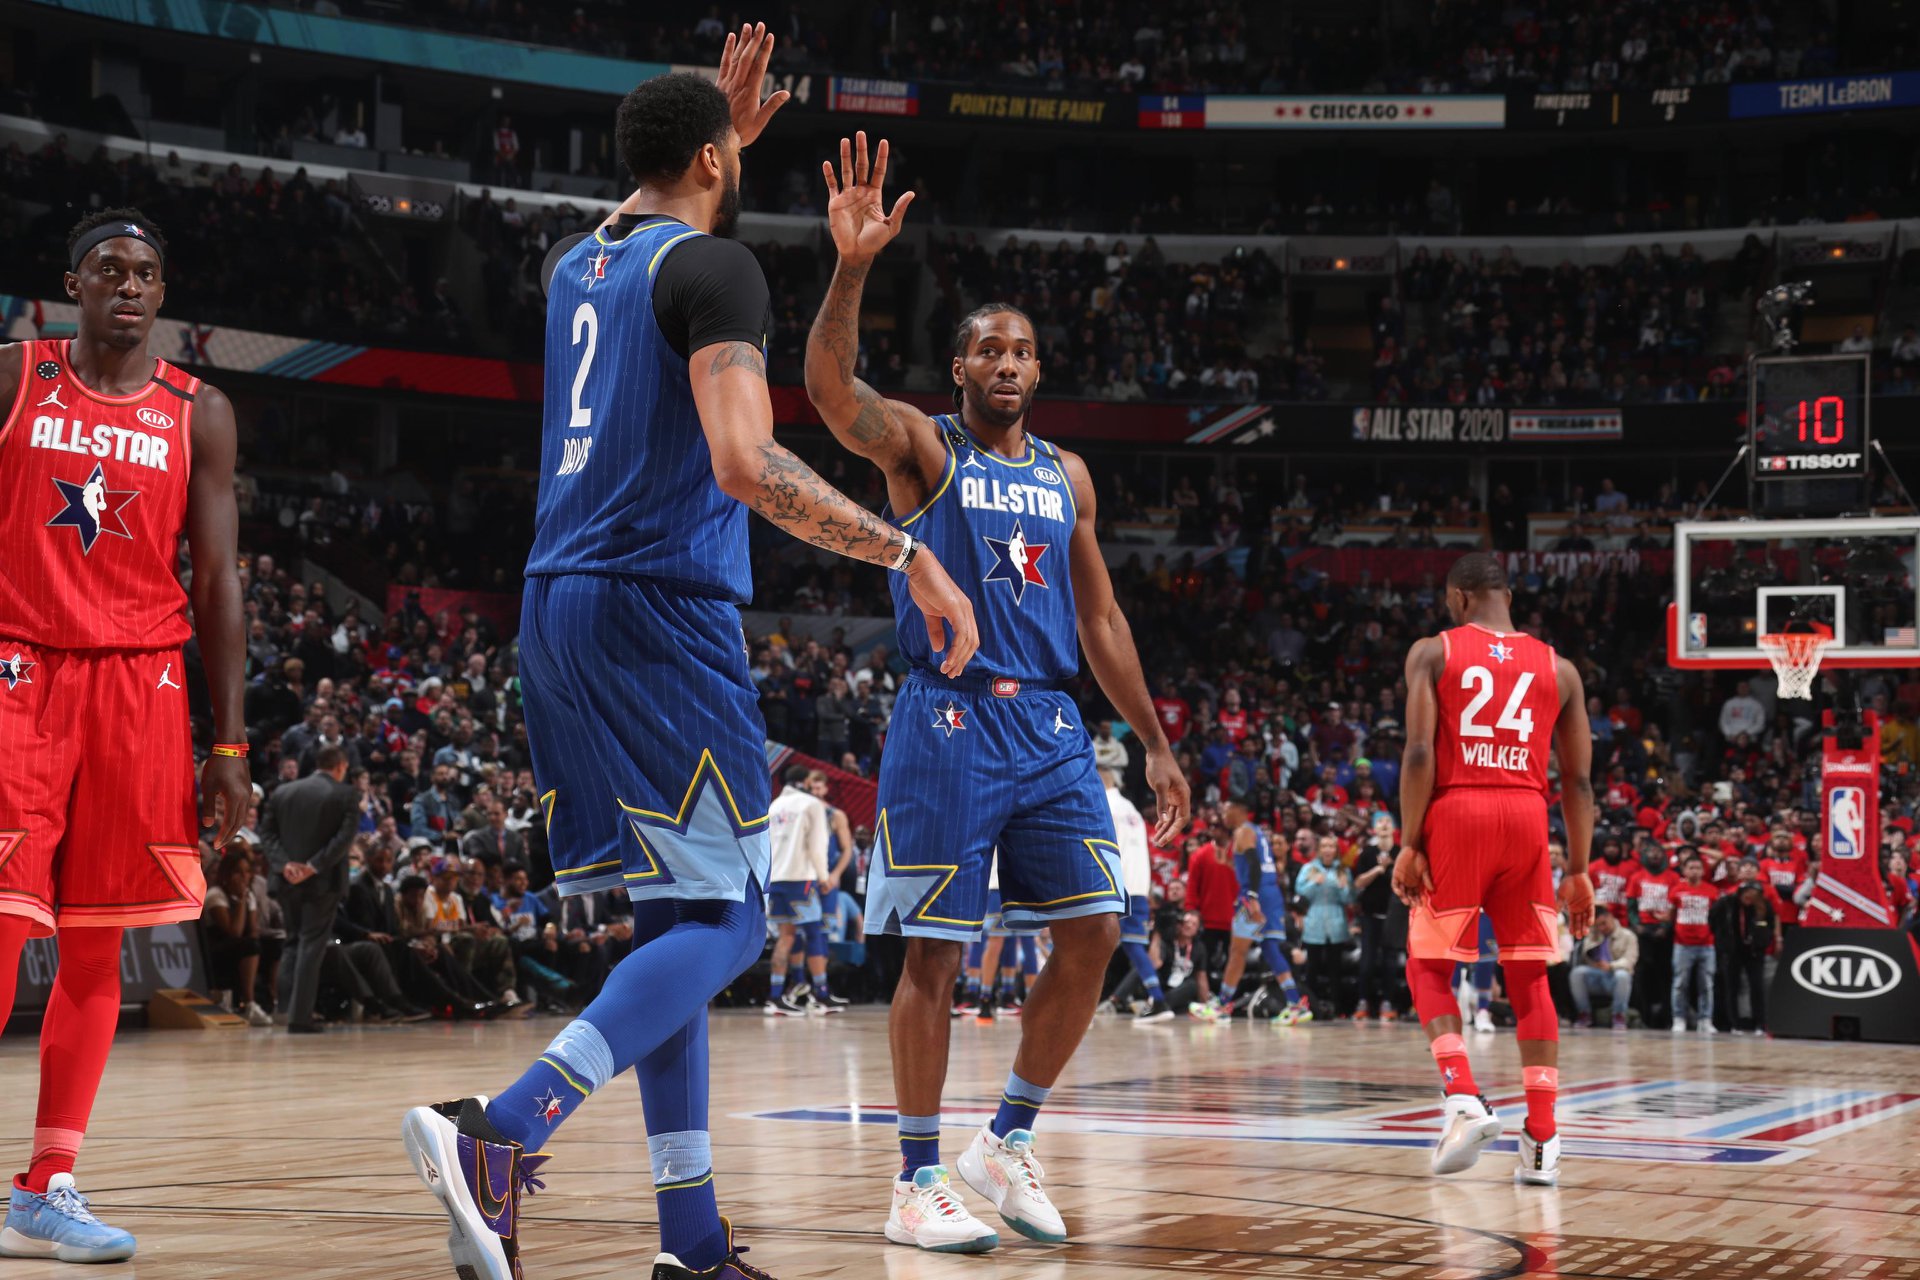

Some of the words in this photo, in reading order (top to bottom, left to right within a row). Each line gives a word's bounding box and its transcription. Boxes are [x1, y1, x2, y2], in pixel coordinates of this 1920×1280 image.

[949, 92, 1008, 117] POINTS
[1009, 96, 1026, 118] IN
[1029, 97, 1058, 120] THE
[1058, 99, 1105, 122] PAINT
[1779, 82, 1824, 109] TEAM
[1310, 104, 1397, 119] CHICAGO
[569, 302, 598, 428] 2
[142, 412, 166, 425] KIA
[1459, 408, 1504, 441] 2020
[1799, 396, 1844, 444] 10
[30, 415, 169, 472] ALL-STAR
[1036, 469, 1057, 483] KIA
[1787, 453, 1861, 470] TISSOT
[962, 477, 1065, 523] ALL-STAR
[1460, 666, 1535, 742] 24
[1461, 743, 1529, 771] WALKER
[1810, 956, 1884, 988] KIA
